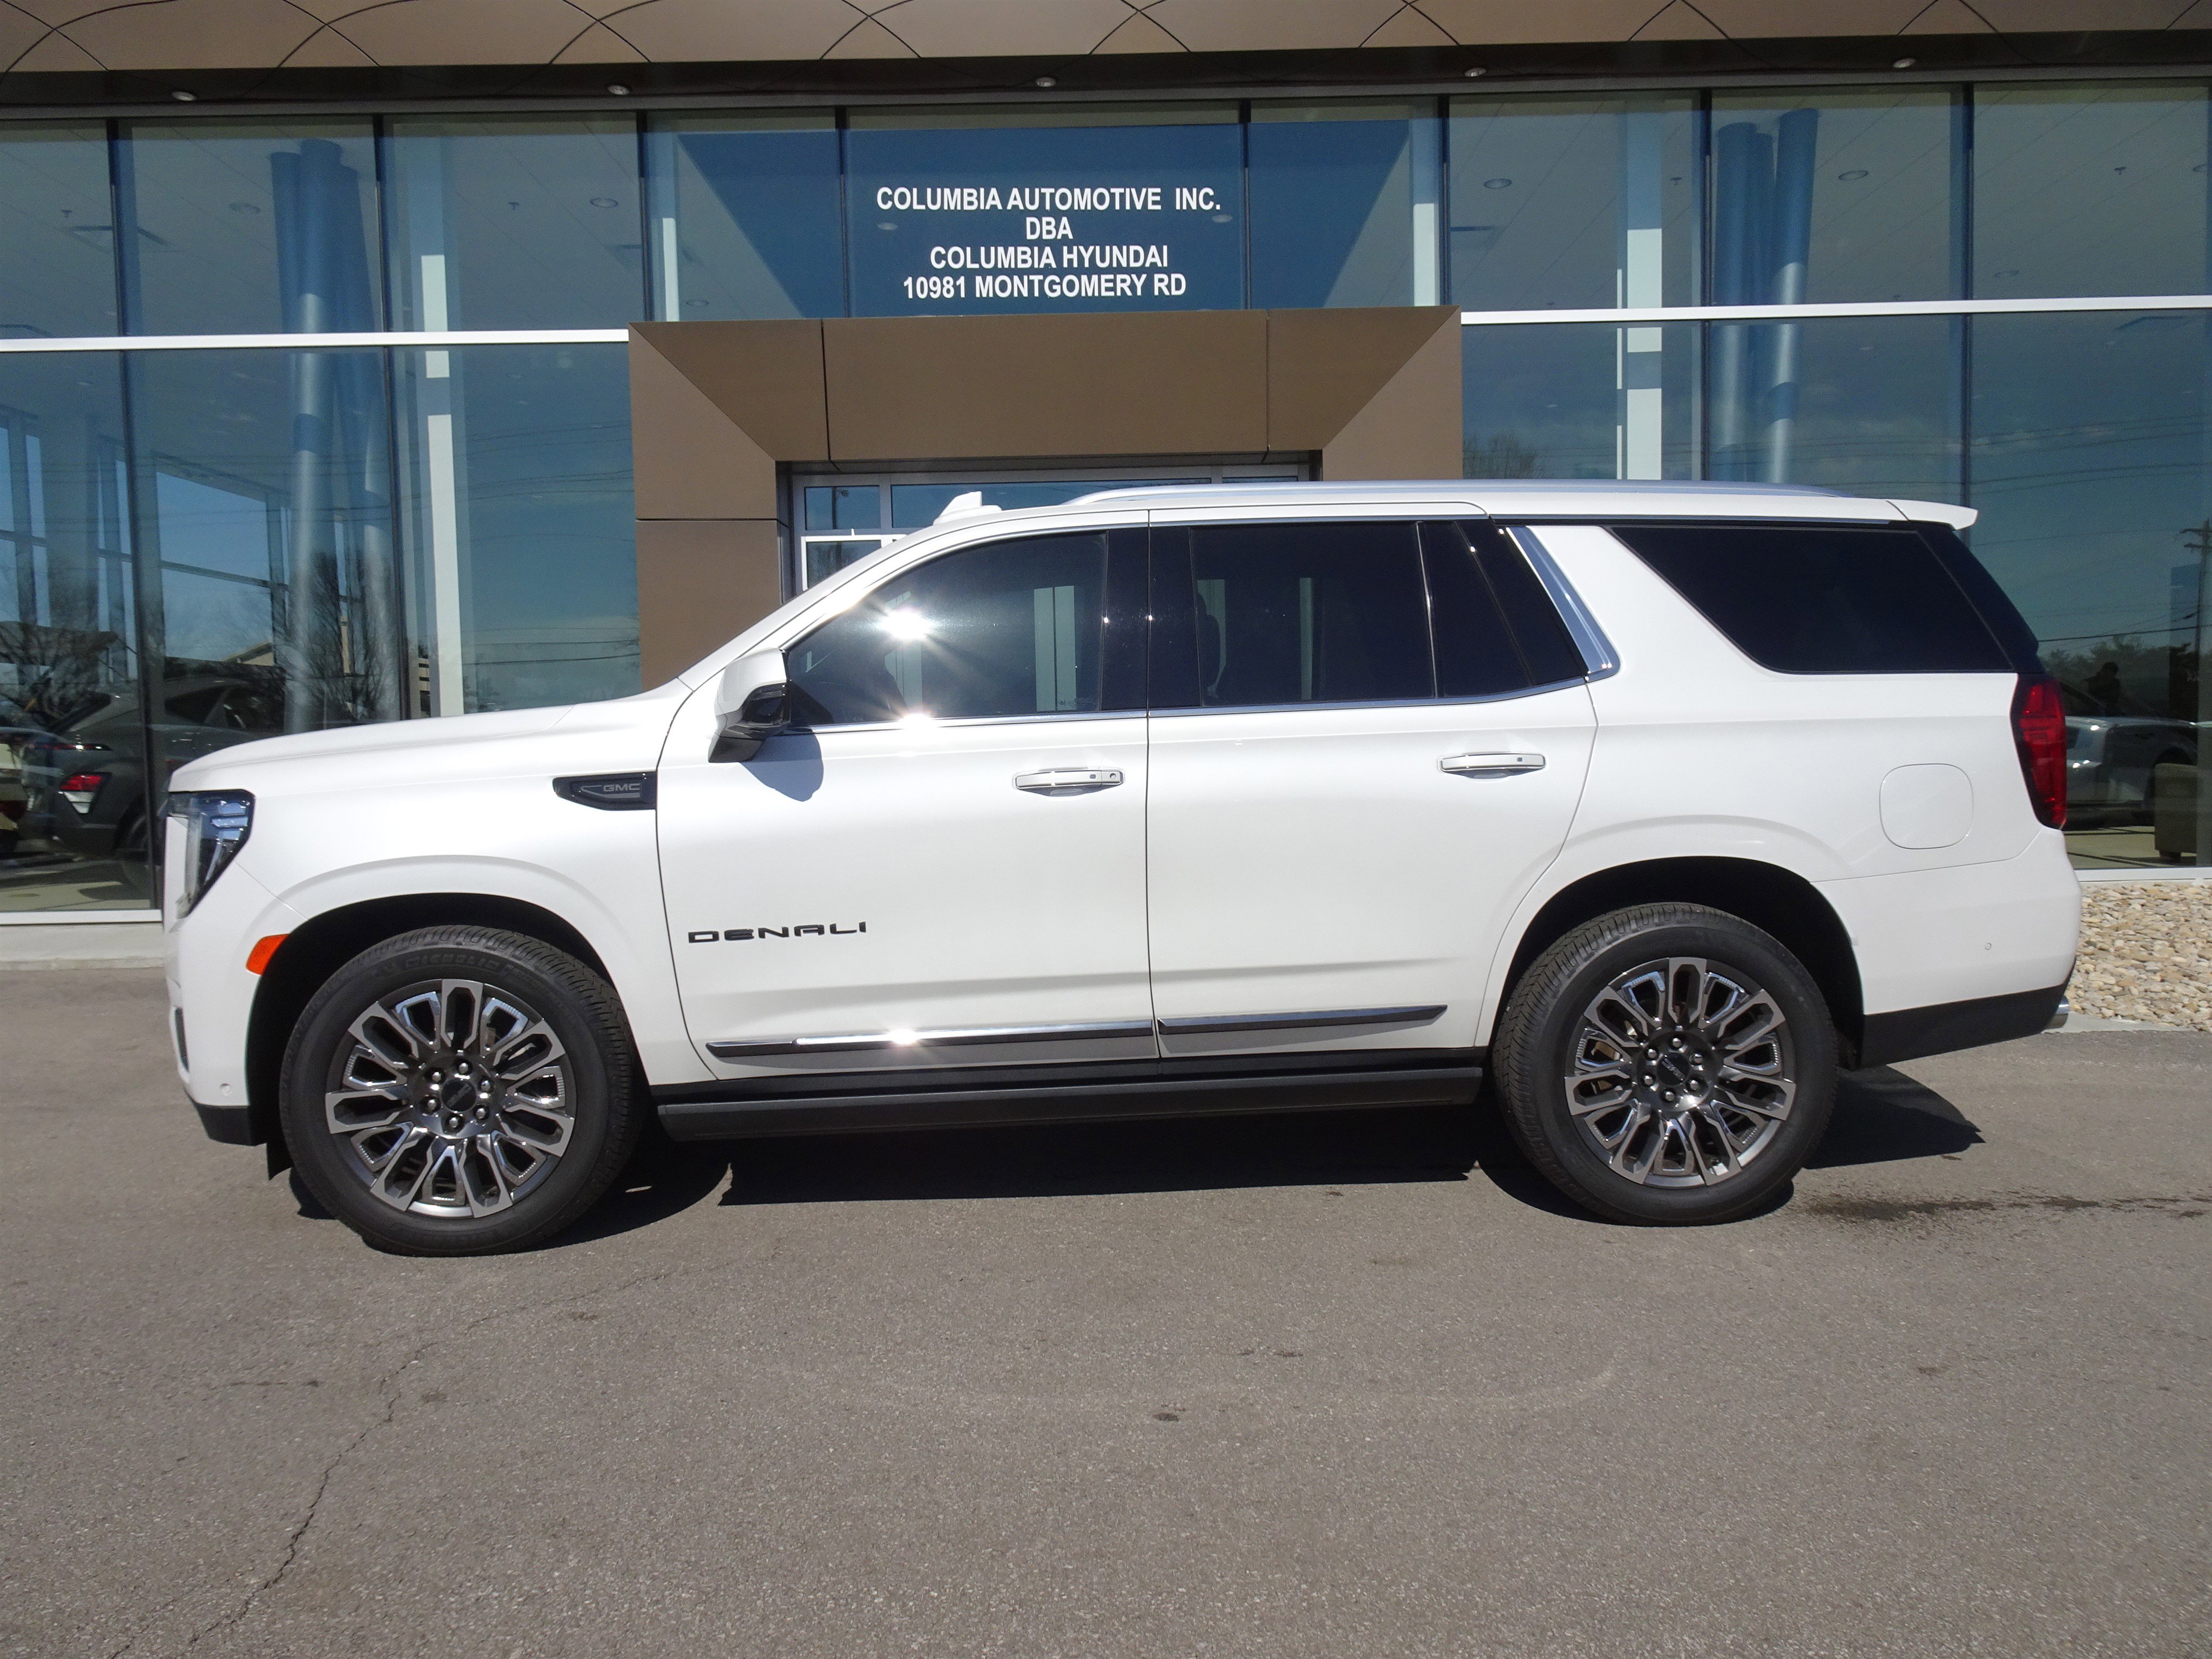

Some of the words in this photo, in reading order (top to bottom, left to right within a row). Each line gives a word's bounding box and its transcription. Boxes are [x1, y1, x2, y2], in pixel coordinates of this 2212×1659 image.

[876, 187, 1002, 210] COLUMBIA
[1007, 187, 1162, 211] AUTOMOTIVE
[1176, 187, 1220, 210] INC.
[1026, 217, 1073, 240] DBA
[930, 246, 1057, 269] COLUMBIA
[1063, 245, 1168, 268] HYUNDAI
[903, 276, 966, 299] 10981
[975, 274, 1147, 298] MONTGOMERY
[1154, 273, 1186, 295] RD
[603, 783, 640, 792] GMC
[688, 921, 866, 943] DENALI
